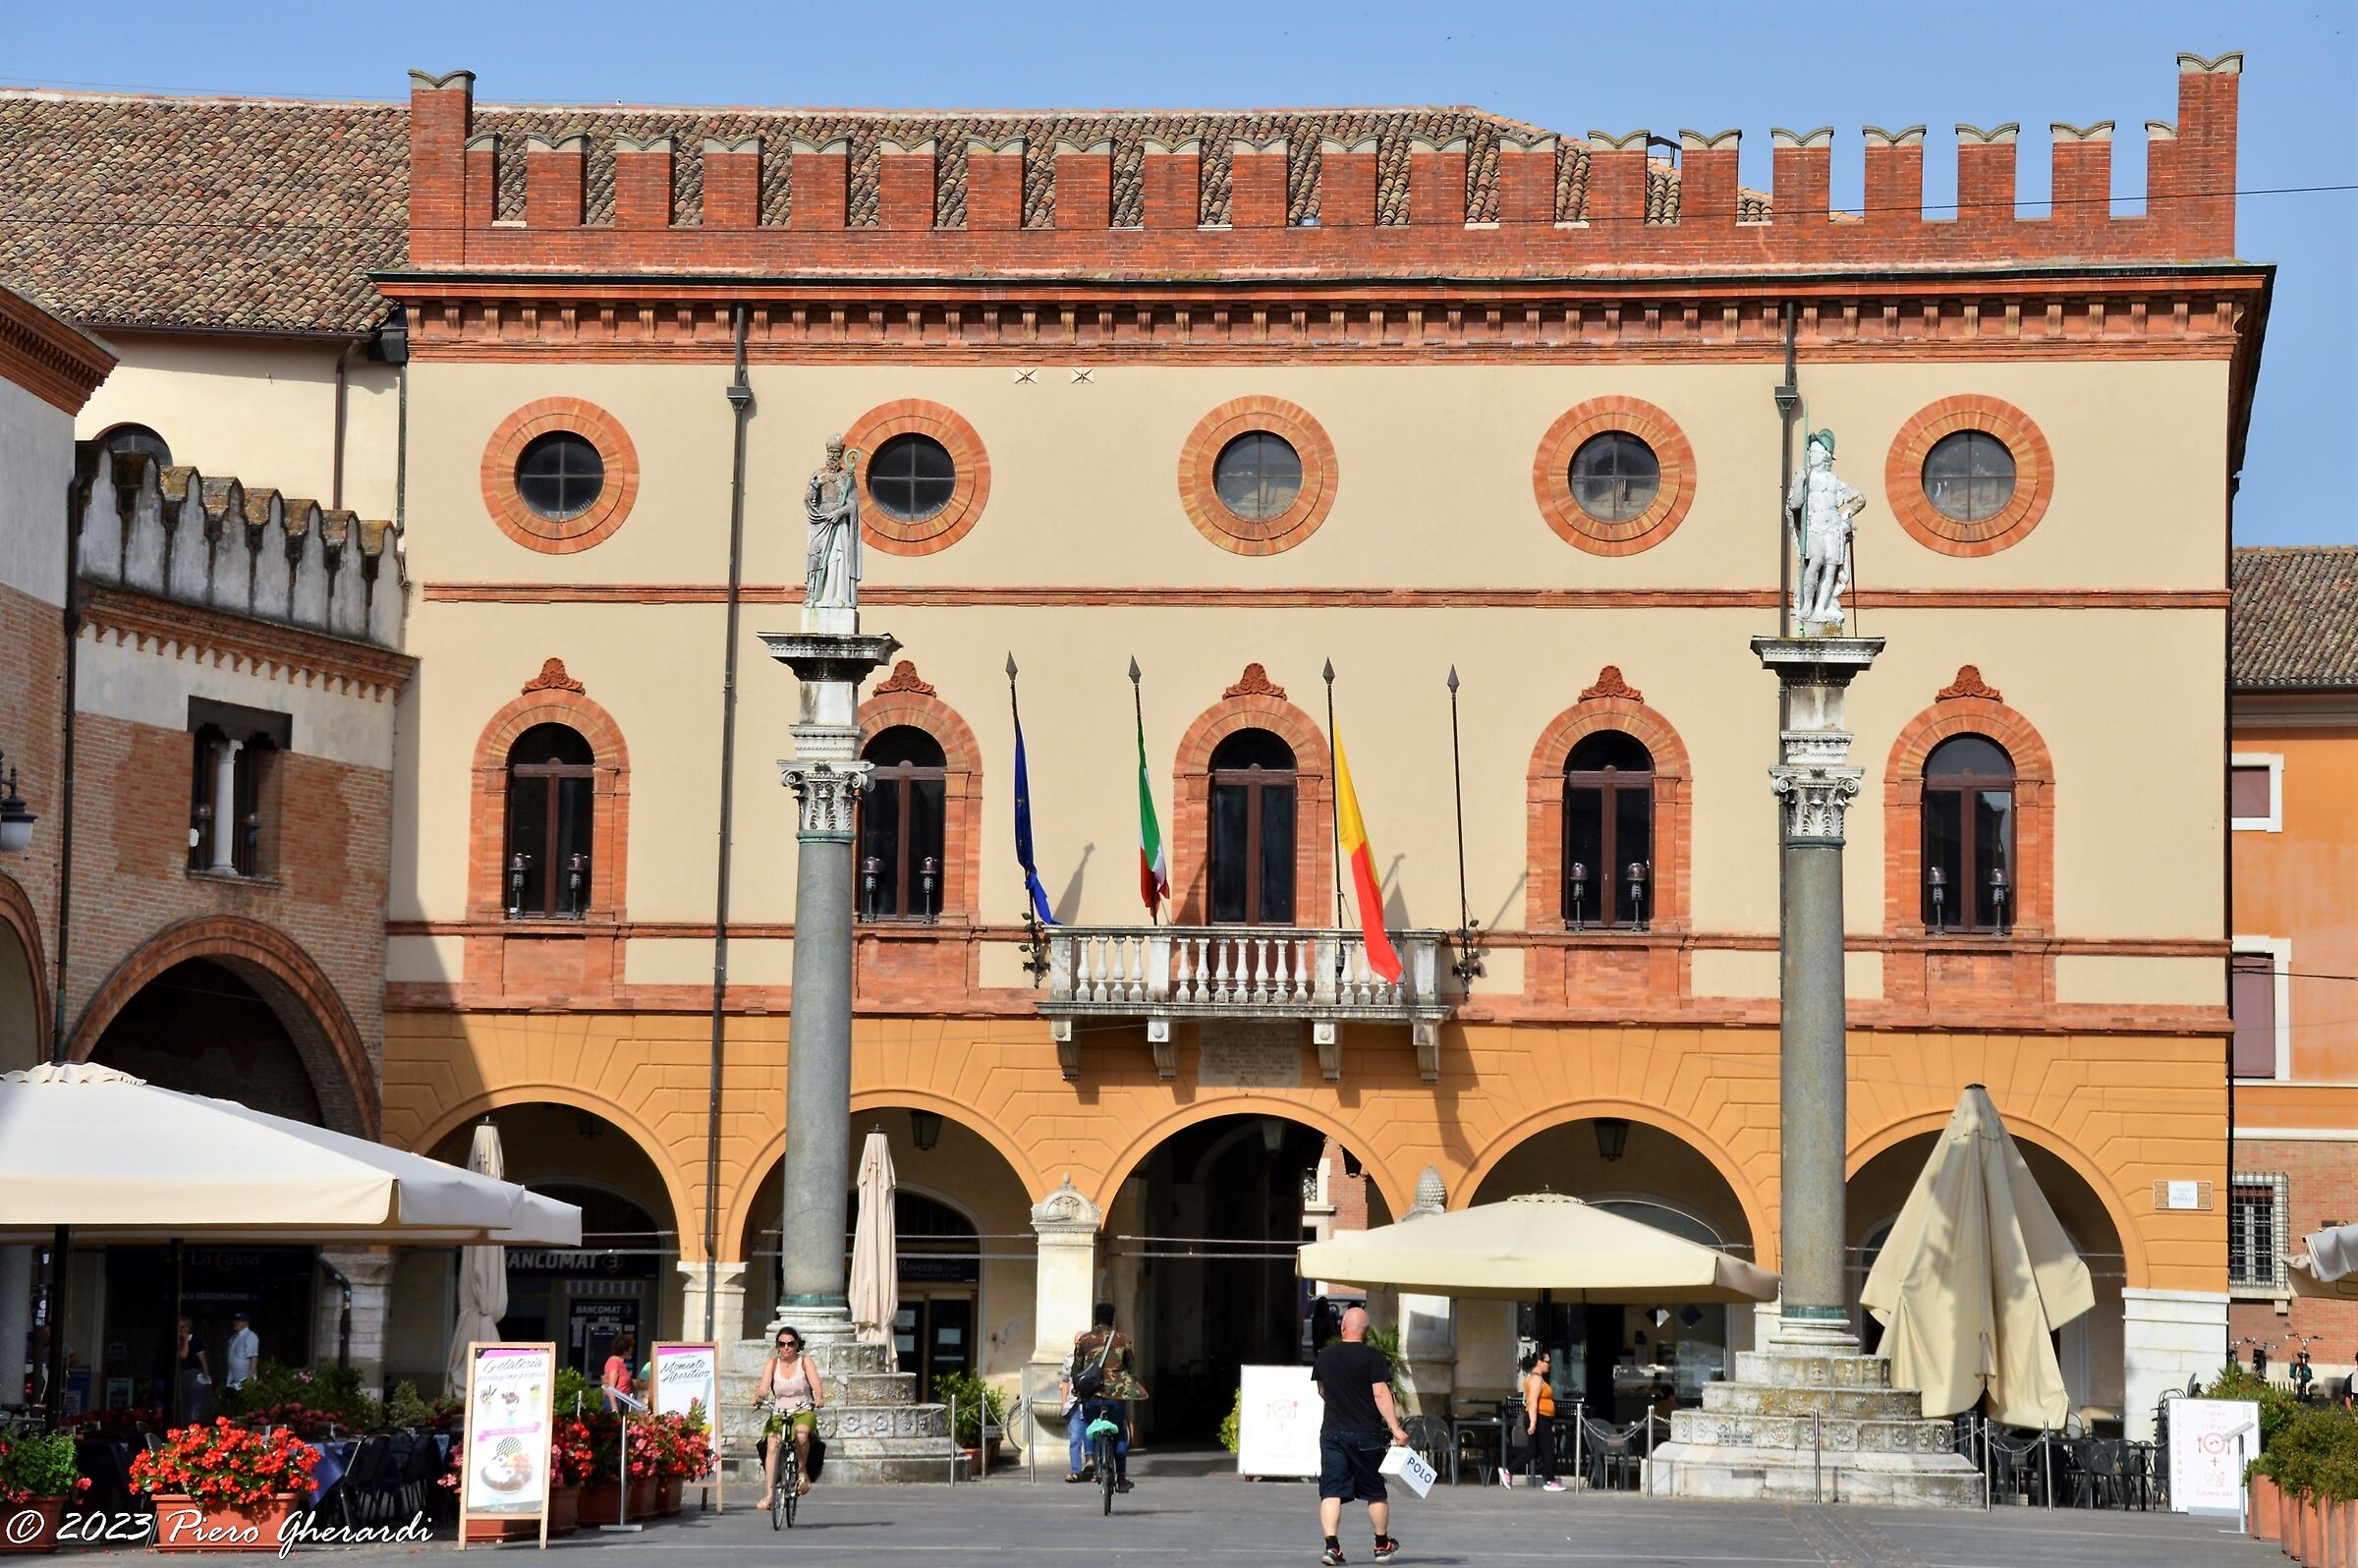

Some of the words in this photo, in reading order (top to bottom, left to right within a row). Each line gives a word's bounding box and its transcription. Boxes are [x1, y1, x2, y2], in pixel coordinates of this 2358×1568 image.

[505, 1253, 596, 1269] ANCOMAT
[575, 1305, 622, 1315] BANCOMAT
[483, 1357, 542, 1373] Gelateria
[660, 1359, 705, 1373] Momento
[660, 1369, 710, 1383] Aperitivo
[1407, 1456, 1432, 1484] POLO
